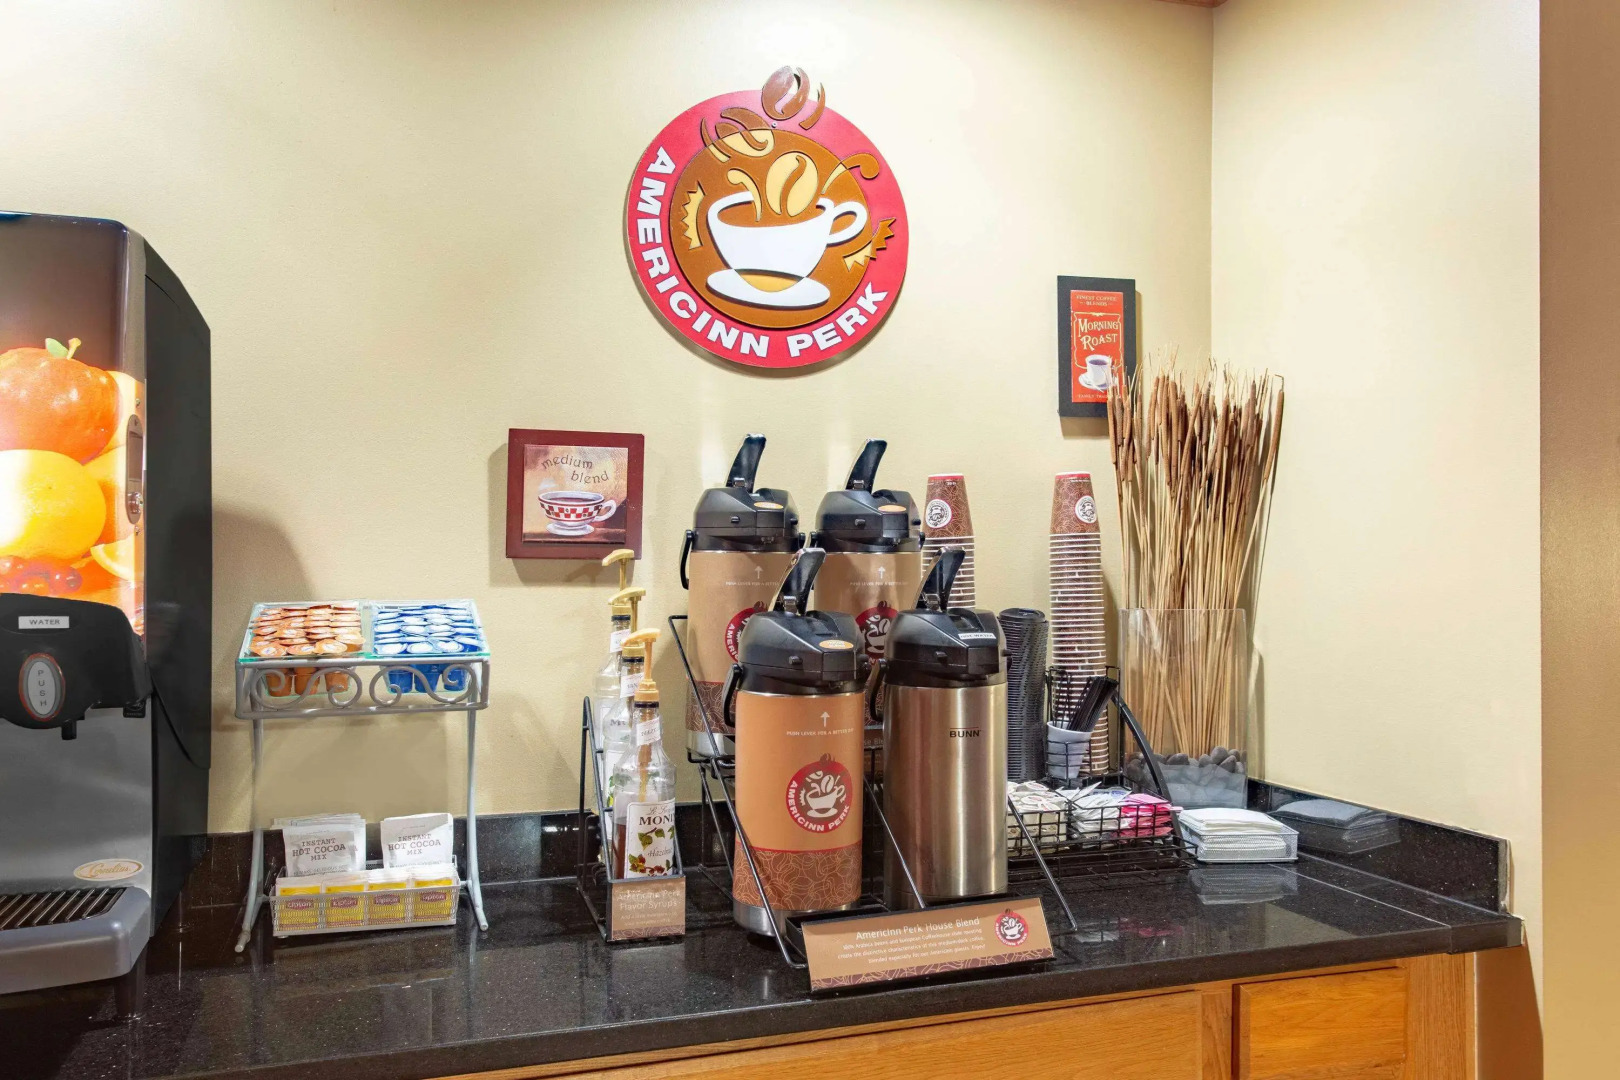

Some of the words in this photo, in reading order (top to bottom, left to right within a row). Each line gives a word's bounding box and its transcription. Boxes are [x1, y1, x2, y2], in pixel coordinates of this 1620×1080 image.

[636, 146, 770, 358] AMERICINN
[786, 281, 888, 358] PERK
[541, 454, 593, 470] medium
[571, 470, 610, 484] blend
[37, 669, 47, 707] PUSH
[949, 730, 980, 738] BUNN
[788, 780, 825, 832] AMERICINN
[828, 805, 850, 830] PERK
[639, 813, 675, 825] MONI
[301, 837, 336, 847] INSTANT
[398, 833, 432, 842] INSTANT
[292, 848, 312, 857] HOT
[313, 843, 346, 854] COCOA
[388, 843, 406, 852] HOT
[410, 839, 441, 849] COCOA
[407, 848, 422, 856] MIX
[903, 924, 923, 934] Perk
[926, 922, 953, 931] House
[955, 916, 980, 928] Blend
